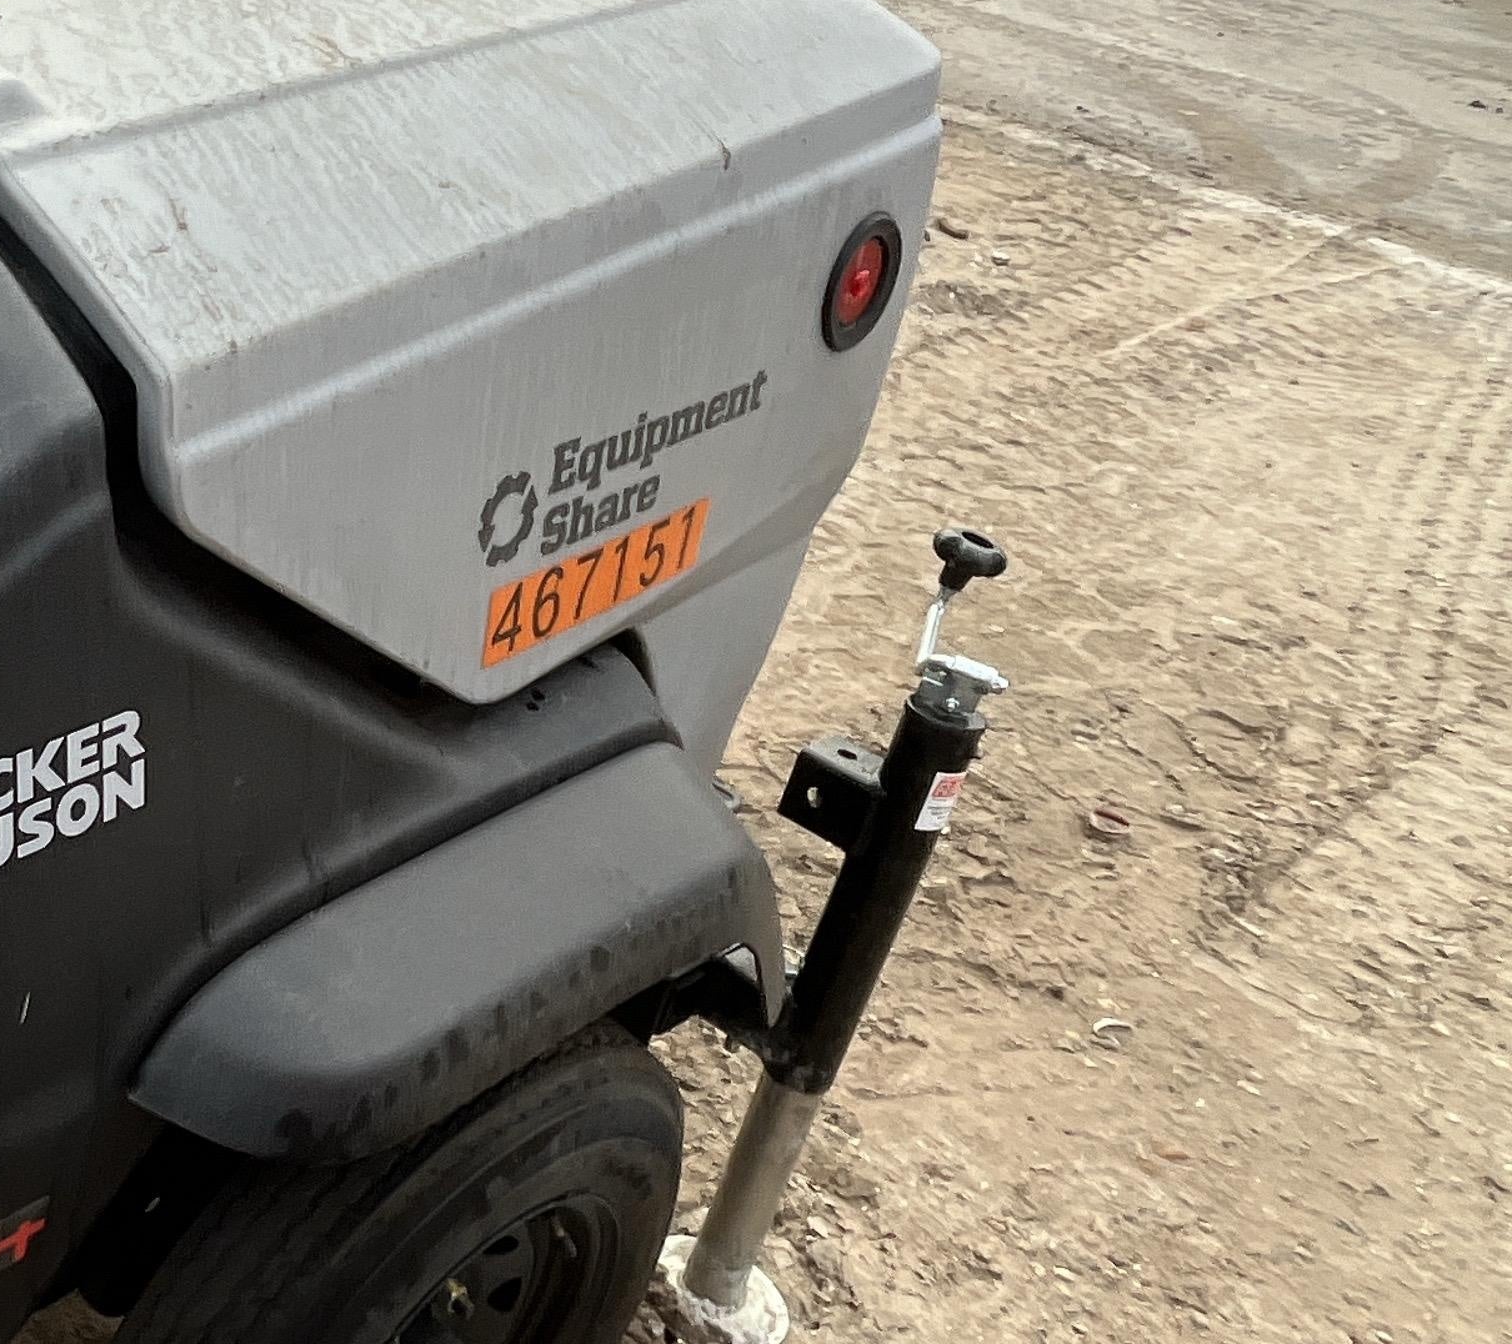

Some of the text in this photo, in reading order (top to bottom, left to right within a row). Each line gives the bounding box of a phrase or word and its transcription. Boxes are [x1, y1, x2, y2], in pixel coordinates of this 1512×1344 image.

[548, 369, 768, 496] Equipment
[541, 474, 661, 556] Share
[491, 505, 697, 653] 467151
